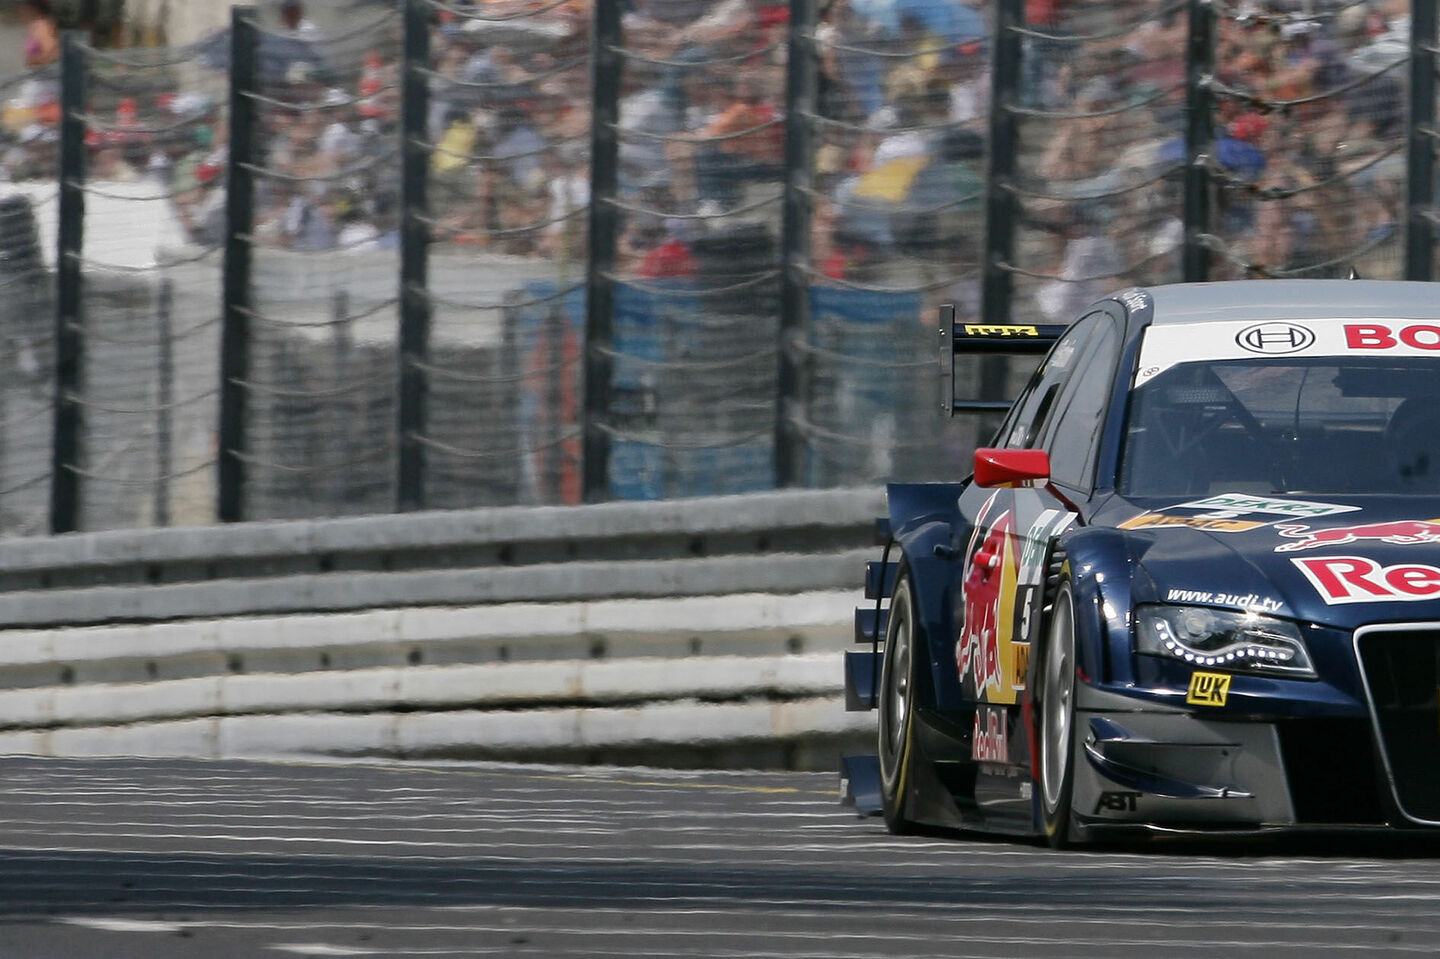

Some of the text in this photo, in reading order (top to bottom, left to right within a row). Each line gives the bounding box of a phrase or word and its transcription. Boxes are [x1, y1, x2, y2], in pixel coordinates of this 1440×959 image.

[1196, 497, 1334, 515] DEKRA
[1167, 588, 1283, 611] www.audi.tv
[1021, 588, 1034, 640] 5
[1093, 791, 1144, 815] ABT
